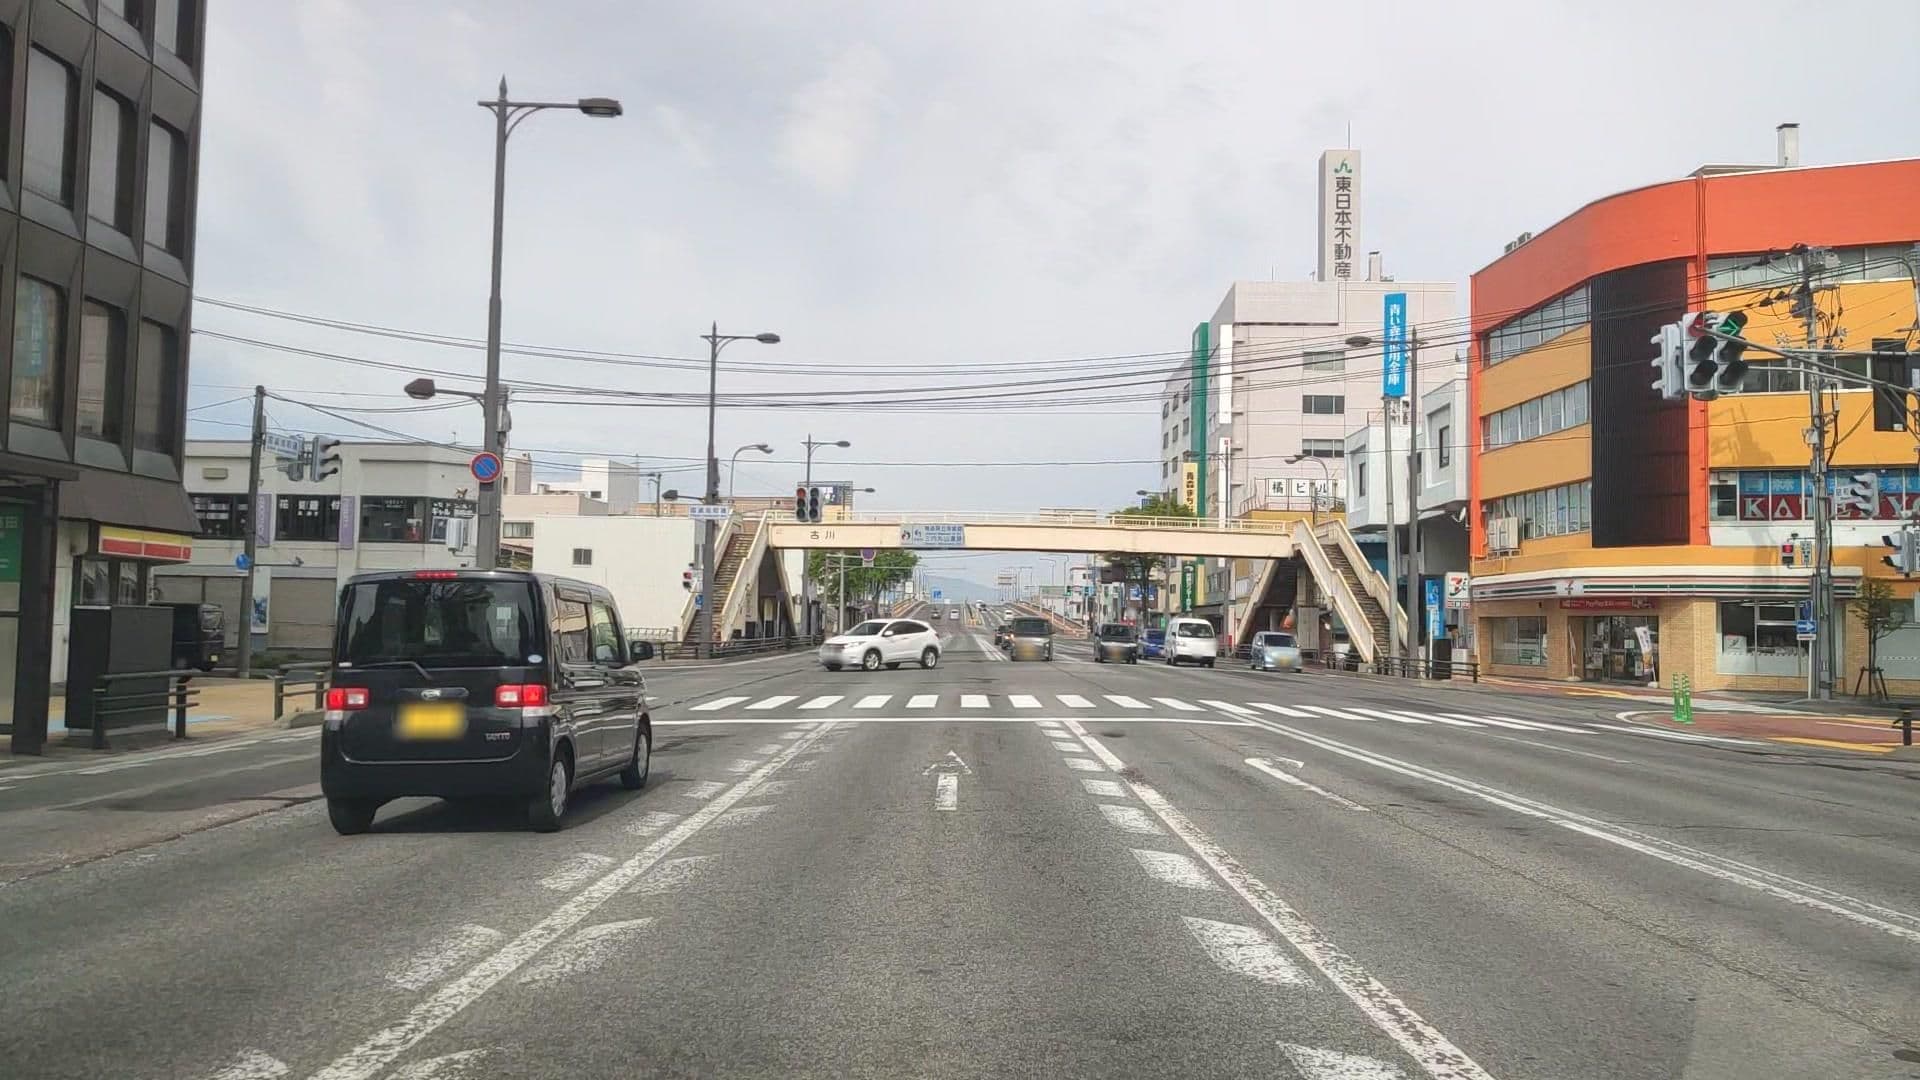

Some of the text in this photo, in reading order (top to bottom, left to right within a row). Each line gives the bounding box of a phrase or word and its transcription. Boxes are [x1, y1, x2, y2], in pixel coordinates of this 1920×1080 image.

[1334, 176, 1352, 278] 東日本不動産
[810, 530, 835, 540] 古川
